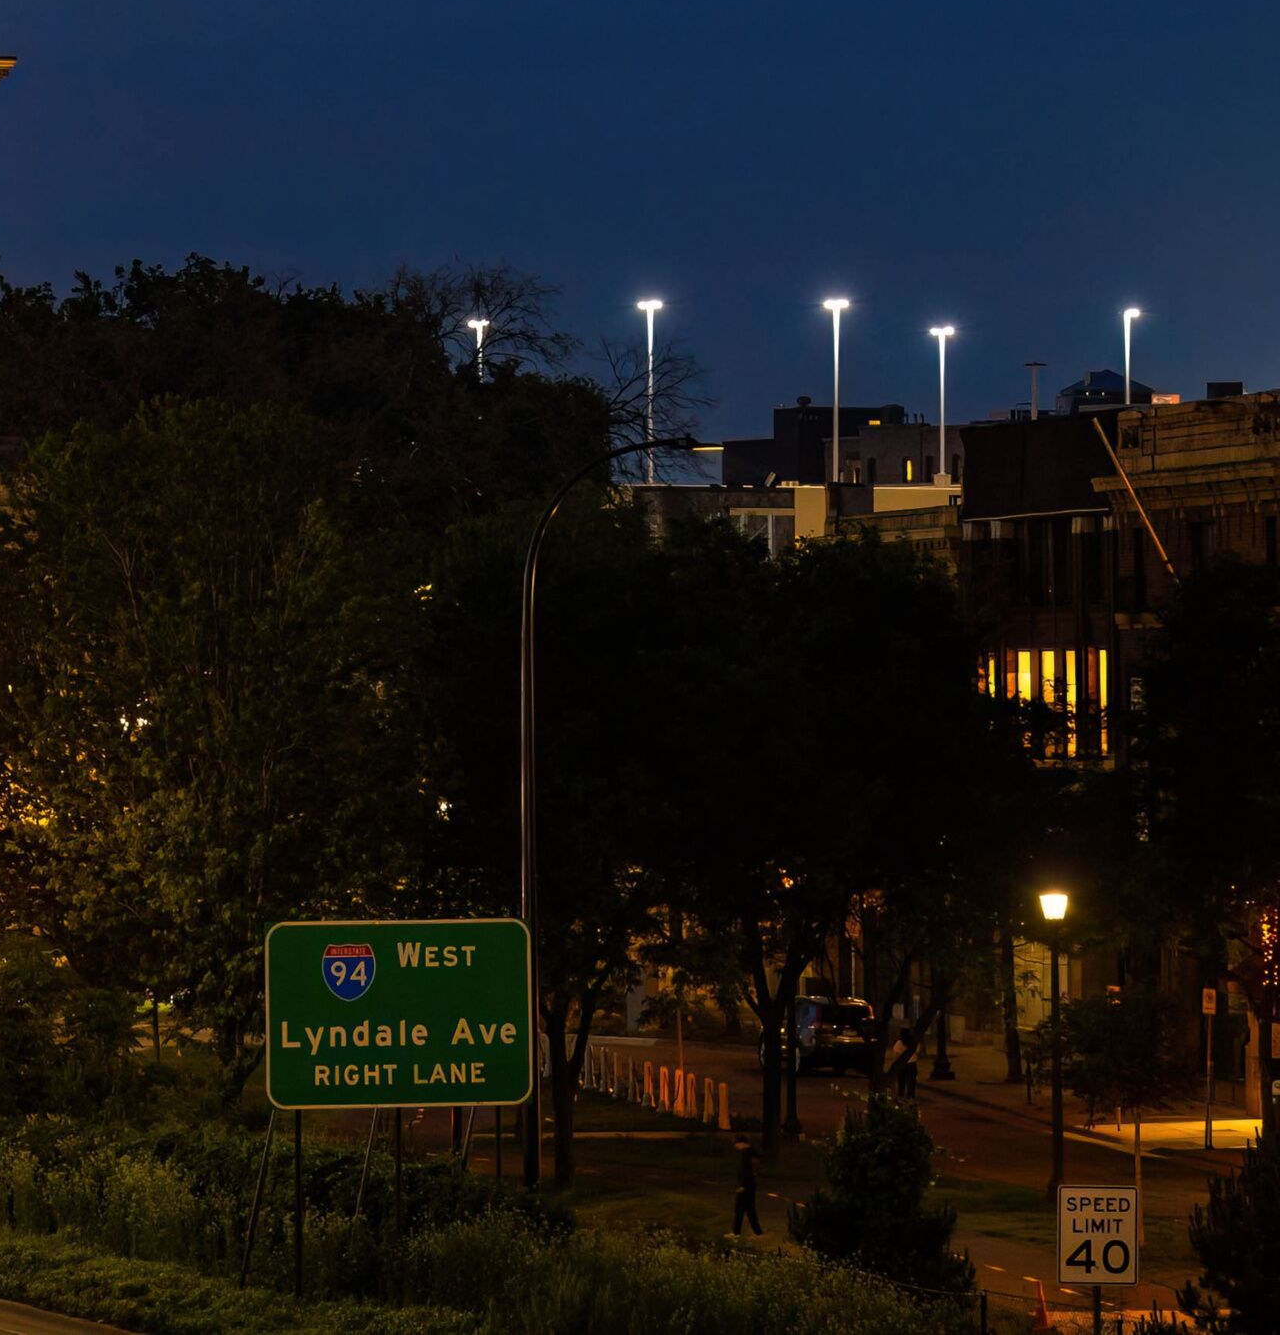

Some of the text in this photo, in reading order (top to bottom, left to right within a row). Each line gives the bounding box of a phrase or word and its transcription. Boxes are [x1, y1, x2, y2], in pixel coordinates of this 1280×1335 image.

[397, 942, 476, 967] WEST
[331, 961, 368, 986] 94
[281, 1018, 517, 1056] Lyndale Ave
[314, 1062, 486, 1086] RIGHT LANE
[1066, 1197, 1131, 1212] SPEED
[1072, 1218, 1123, 1233] LIMIT
[1065, 1239, 1130, 1274] 40
